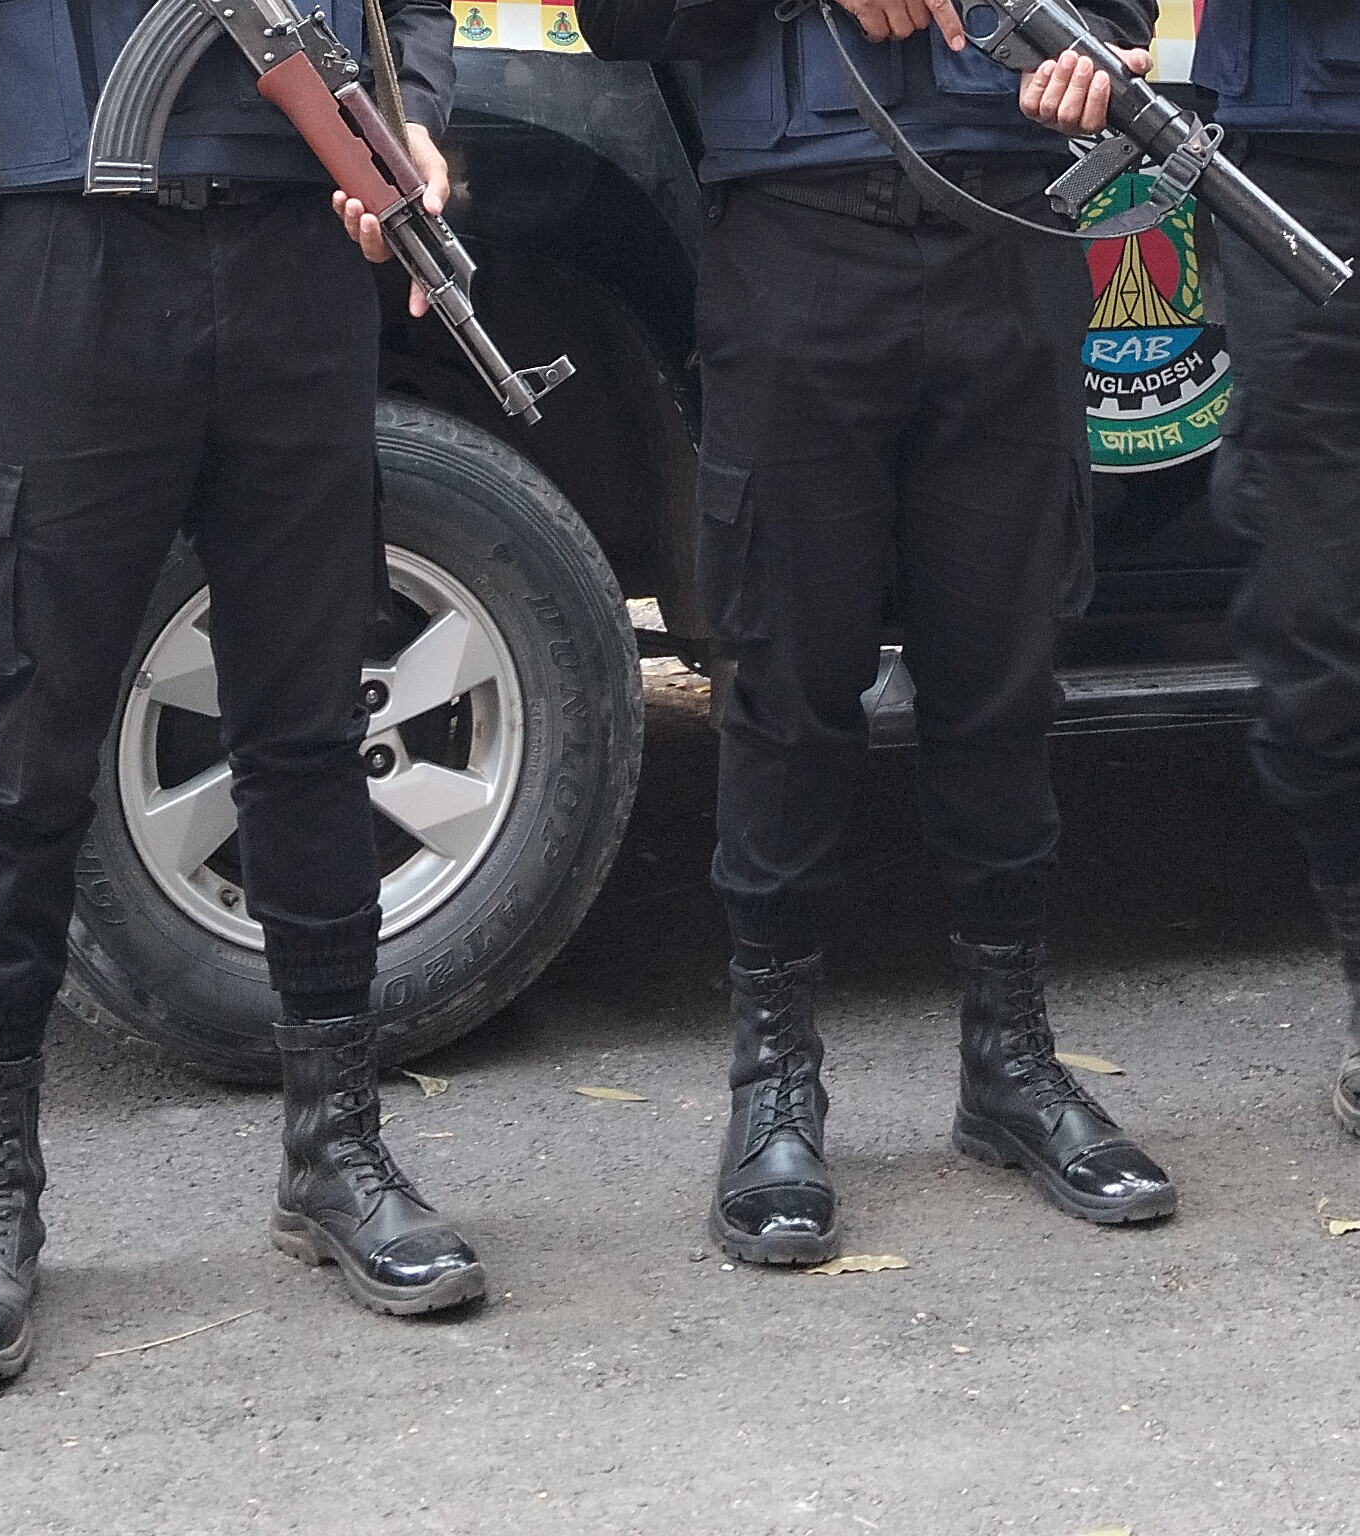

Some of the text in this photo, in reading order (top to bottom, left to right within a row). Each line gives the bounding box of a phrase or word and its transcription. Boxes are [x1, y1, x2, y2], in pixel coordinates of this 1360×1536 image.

[1089, 335, 1173, 364] RAB
[1083, 350, 1204, 395] NGLADESH
[1098, 421, 1183, 455] আমার
[522, 592, 589, 862] DUNLOP
